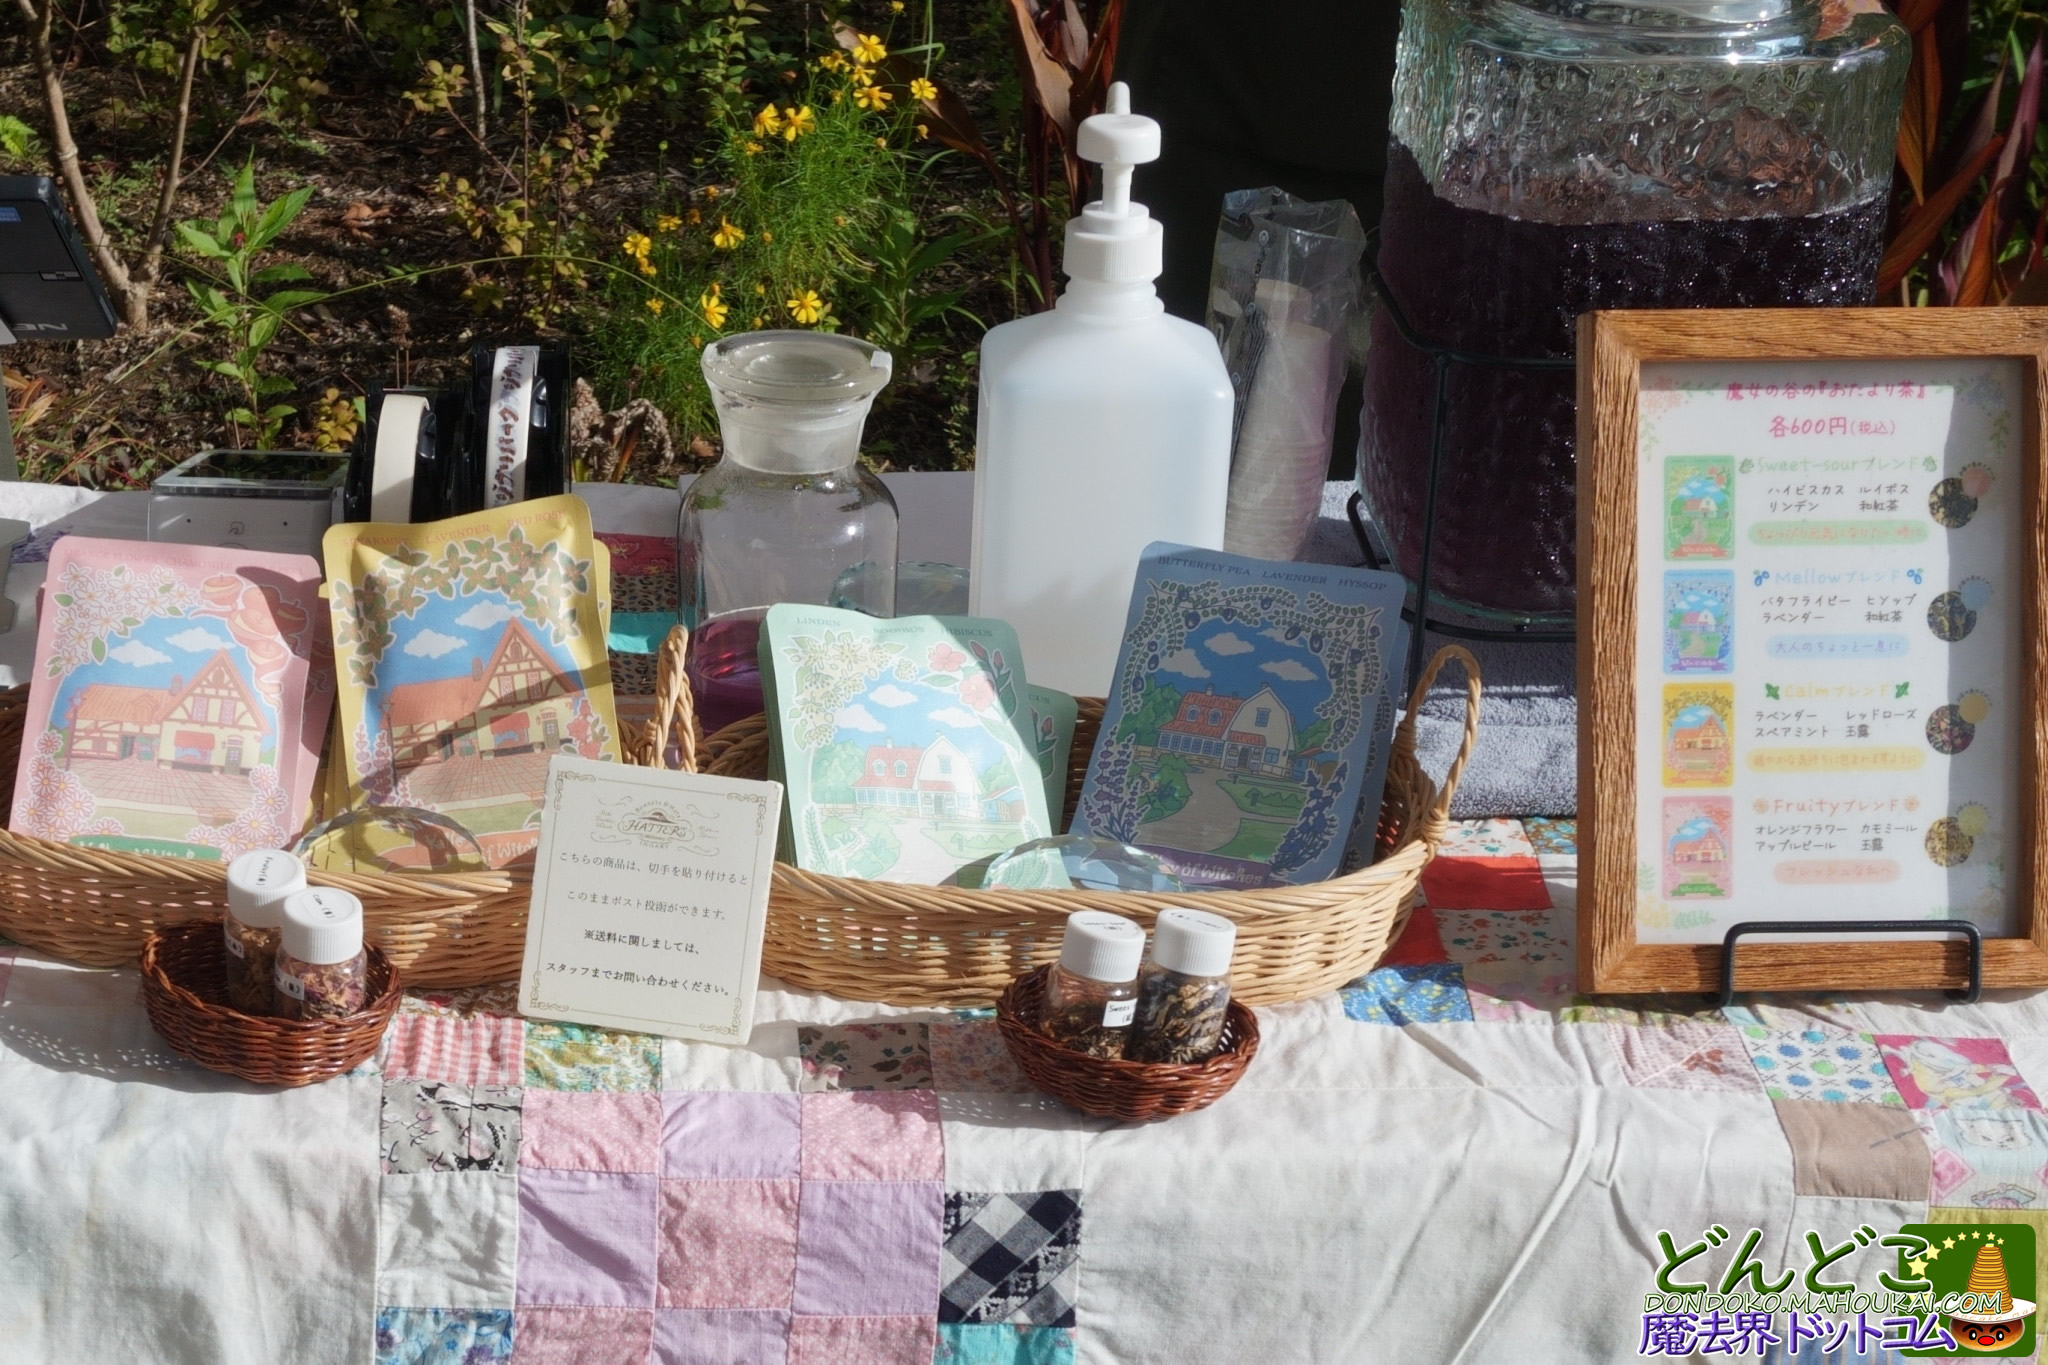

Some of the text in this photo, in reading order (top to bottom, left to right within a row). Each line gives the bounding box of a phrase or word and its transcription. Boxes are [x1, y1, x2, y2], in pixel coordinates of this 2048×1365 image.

[13, 323, 68, 331] NE
[1768, 484, 1910, 496] ハイビスカス ルイボス
[1769, 499, 1900, 512] リンデン 和紅茶
[425, 523, 490, 545] LAVENDER
[508, 515, 532, 528] RED
[1158, 555, 1388, 592] BUTTERFLY PEA LAVENDER HYSSOP
[1761, 593, 1917, 607] バタフライピー ヒソップ
[797, 616, 841, 628] LINDEN
[1762, 610, 1903, 624] ラベンダー 和紅茶
[1755, 708, 1917, 722] ラベンダー レッドローズ
[1755, 724, 1870, 738] スペアミント 玉露
[623, 819, 688, 838] HATTER'S
[1755, 823, 1918, 836] オレンジフラワー カモミール
[1755, 839, 1884, 852] アップルピール 玉露
[559, 851, 749, 886] こちらの商品は、切手を貼り付けると
[567, 889, 727, 921] このままポスト投函ができます。
[583, 928, 701, 956] ※送料に関しましては、
[546, 961, 730, 997] スタッフまでお問い合わせください。
